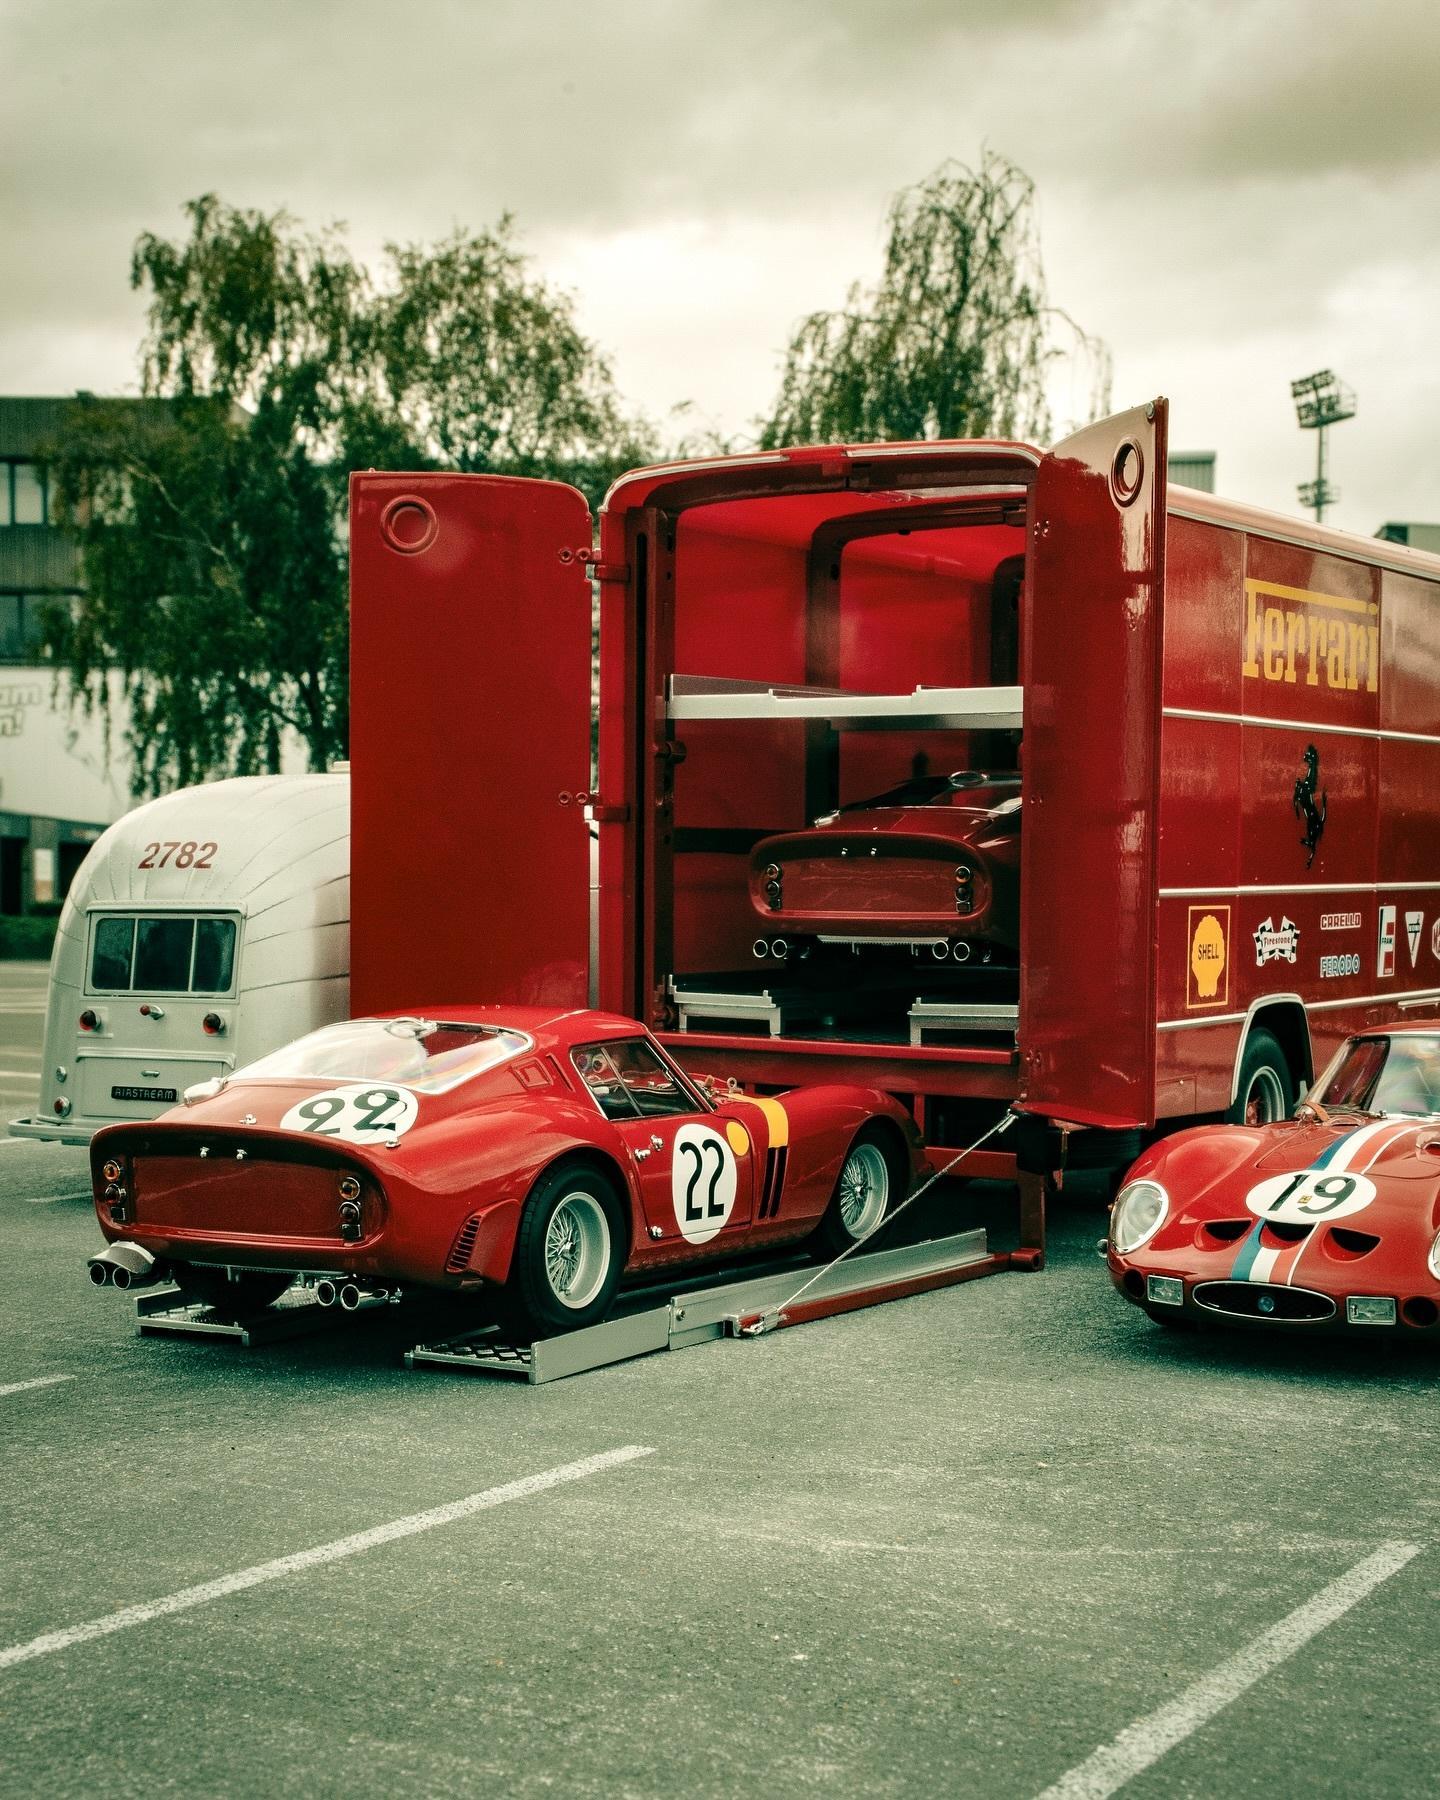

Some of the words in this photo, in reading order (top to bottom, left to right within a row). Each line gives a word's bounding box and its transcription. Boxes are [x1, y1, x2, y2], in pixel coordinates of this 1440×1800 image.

[1243, 578, 1379, 692] Ferrari
[138, 841, 218, 869] 2782
[1321, 913, 1361, 930] CARELLO
[1197, 943, 1219, 960] SHELL
[1320, 953, 1360, 978] FERODO
[114, 1088, 174, 1099] AIRSTREAM
[299, 1089, 400, 1135] 22
[680, 1139, 724, 1221] 22
[1267, 1173, 1357, 1215] 19
